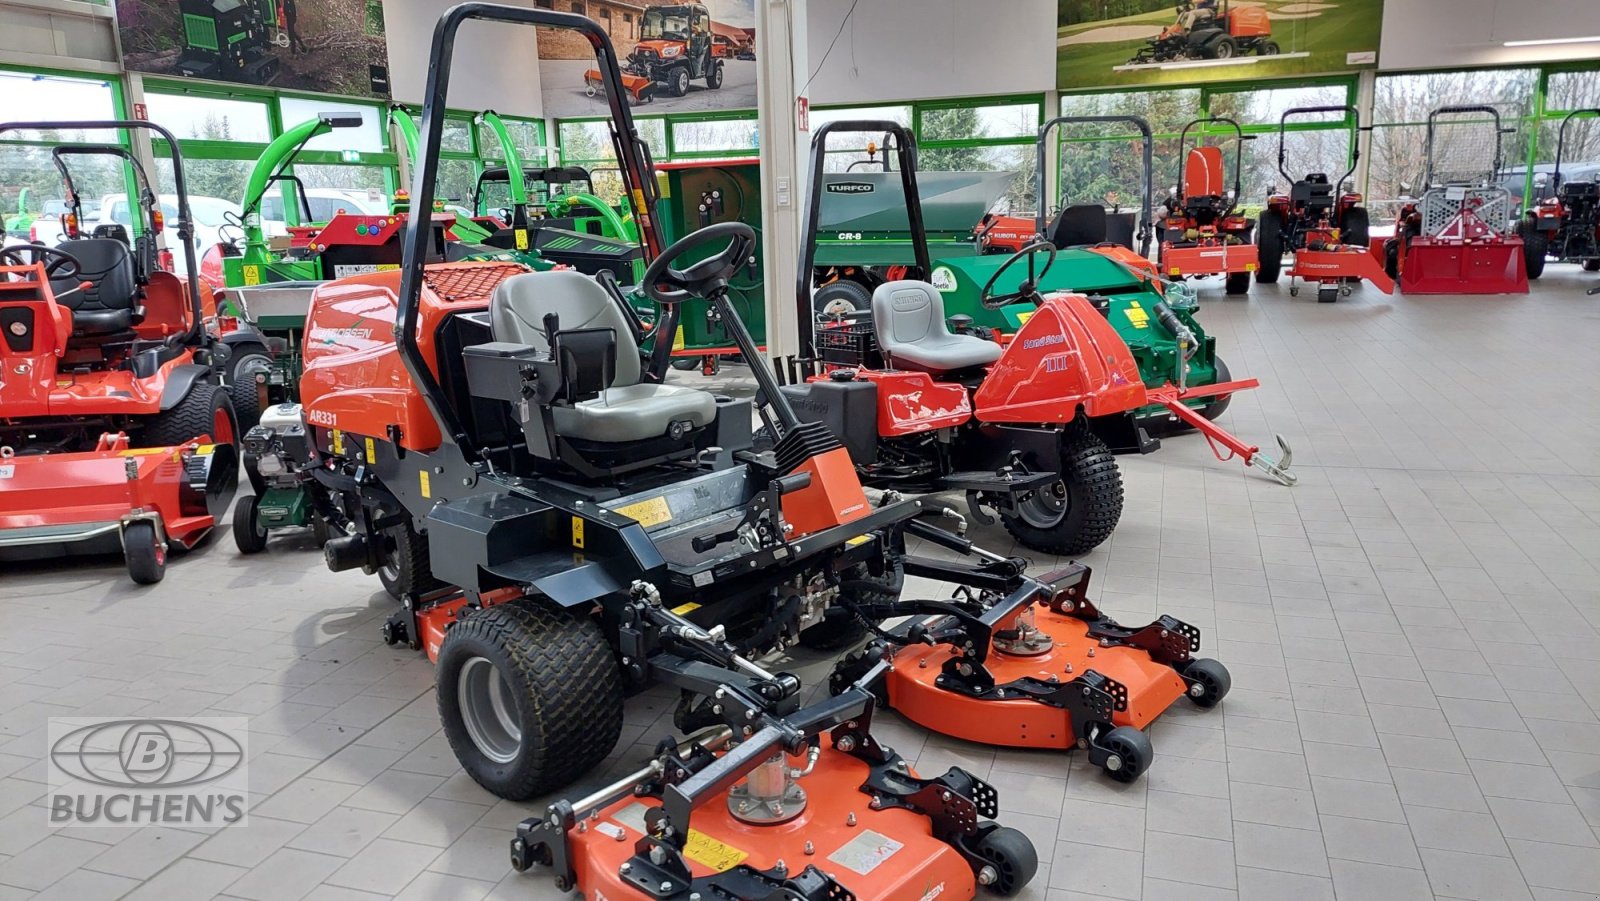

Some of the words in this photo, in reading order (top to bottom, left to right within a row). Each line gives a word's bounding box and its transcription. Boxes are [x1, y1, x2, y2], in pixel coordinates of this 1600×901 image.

[838, 232, 862, 240] CR-8
[1024, 336, 1045, 349] Sand
[310, 409, 337, 427] AR331
